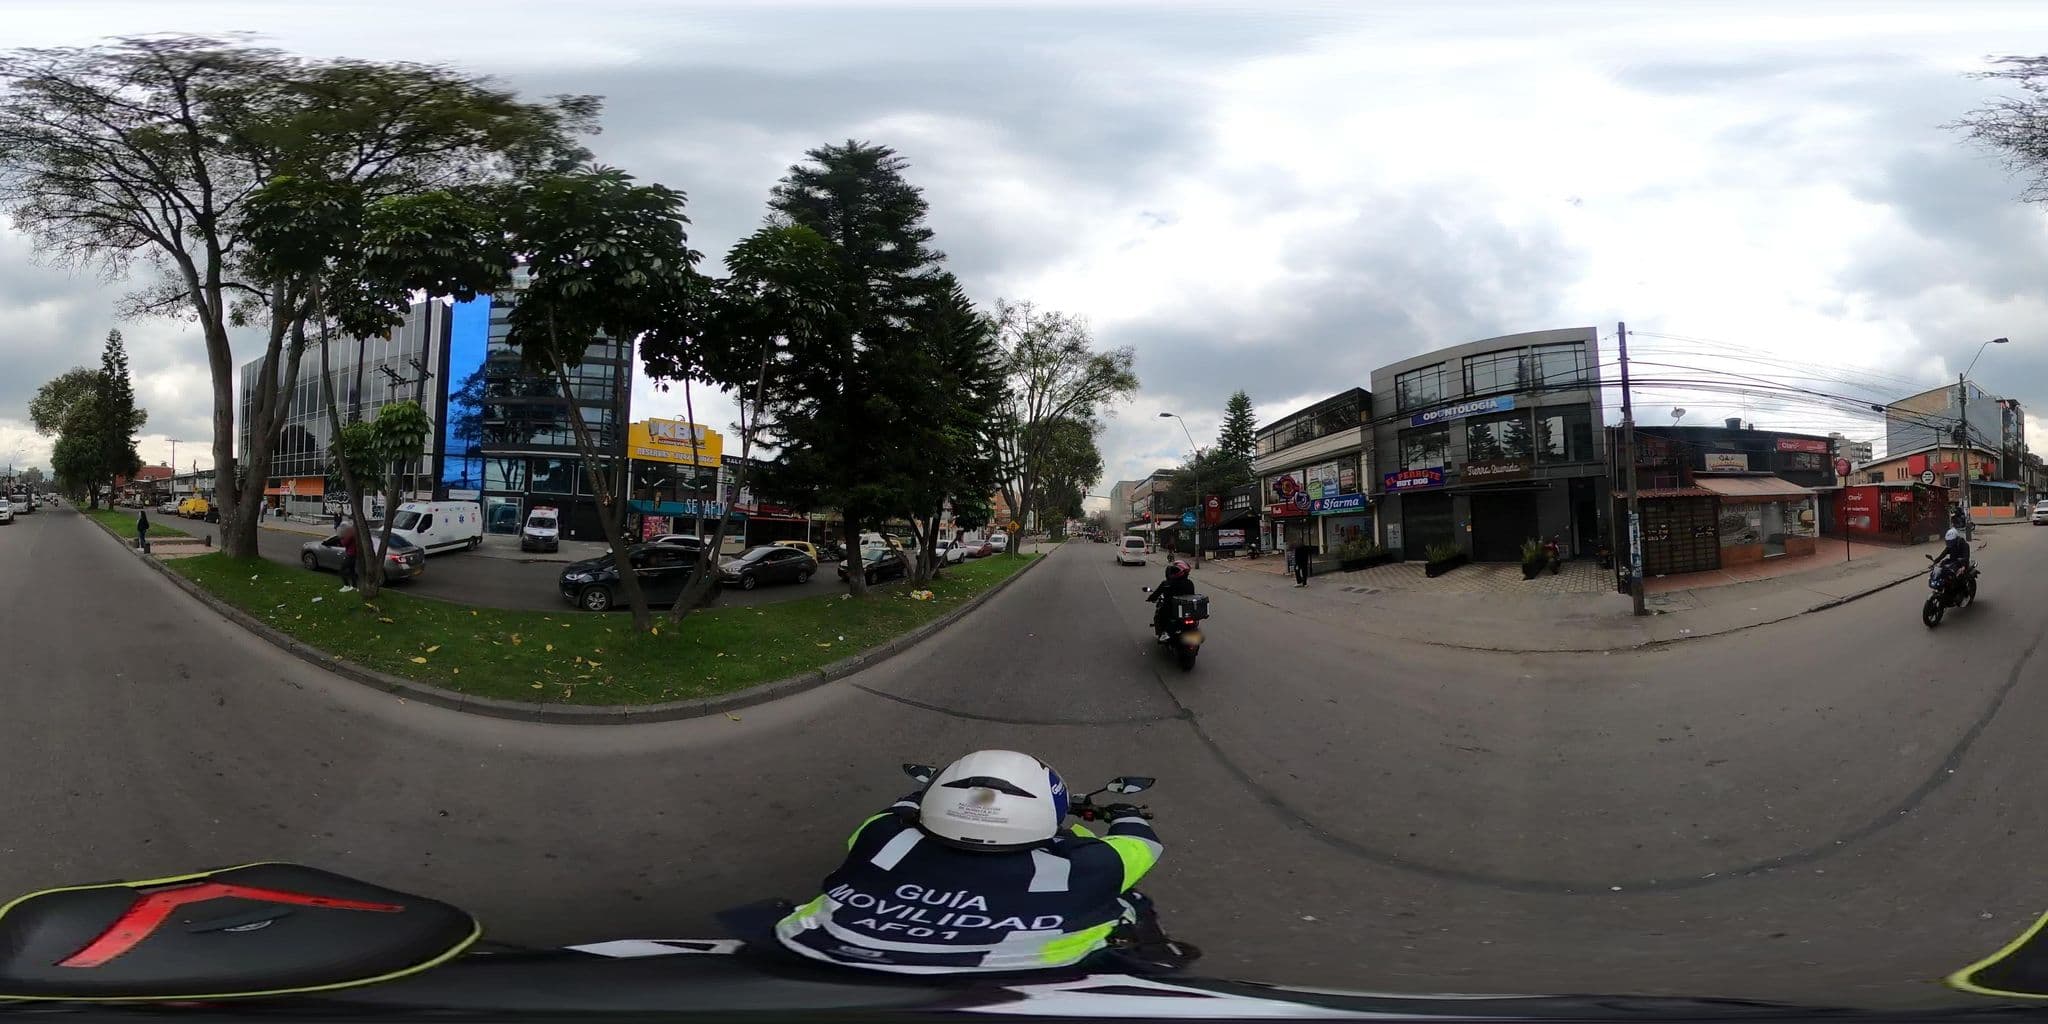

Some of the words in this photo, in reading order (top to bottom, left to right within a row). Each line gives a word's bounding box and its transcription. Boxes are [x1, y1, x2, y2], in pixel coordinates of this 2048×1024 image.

[1323, 498, 1360, 510] Sfarma
[828, 883, 1064, 930] MOVILIDAD
[895, 884, 989, 912] GUÍA
[852, 917, 959, 940] AF01
